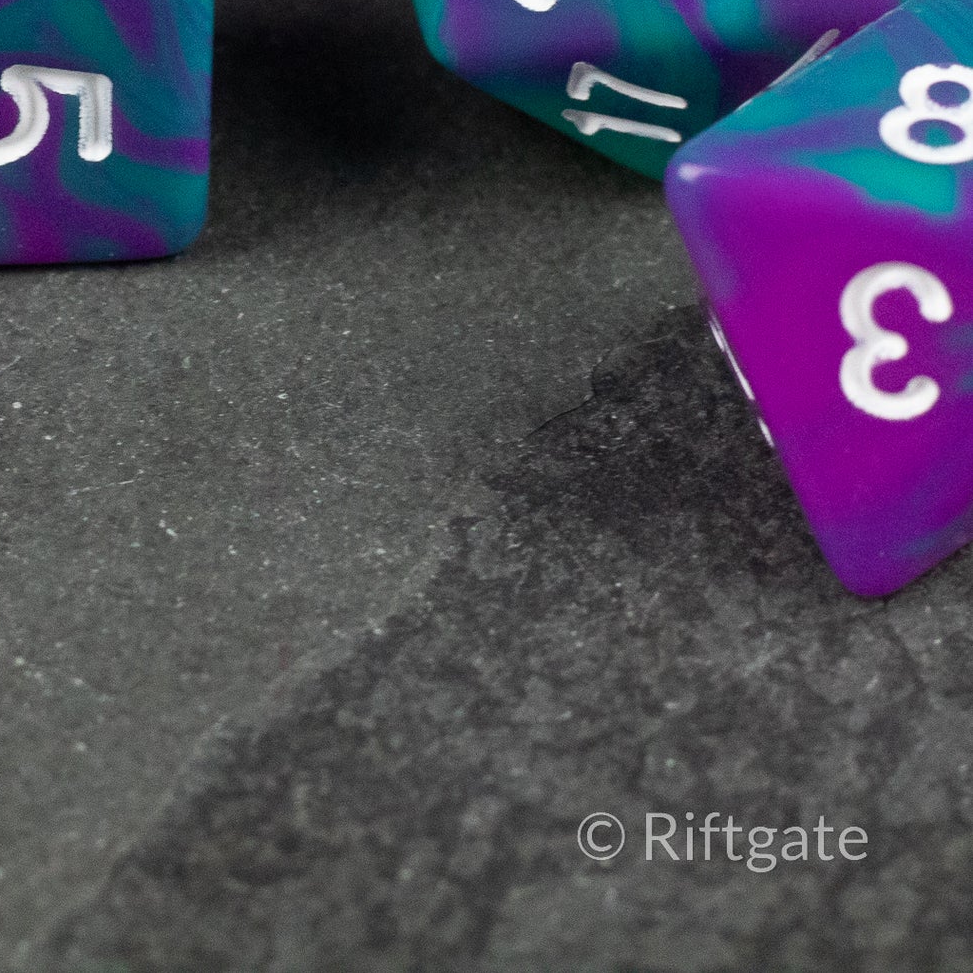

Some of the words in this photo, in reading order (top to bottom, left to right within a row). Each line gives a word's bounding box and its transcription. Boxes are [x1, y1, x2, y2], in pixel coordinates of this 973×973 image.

[561, 59, 688, 144] 17
[877, 62, 973, 166] 8
[838, 260, 954, 422] 3
